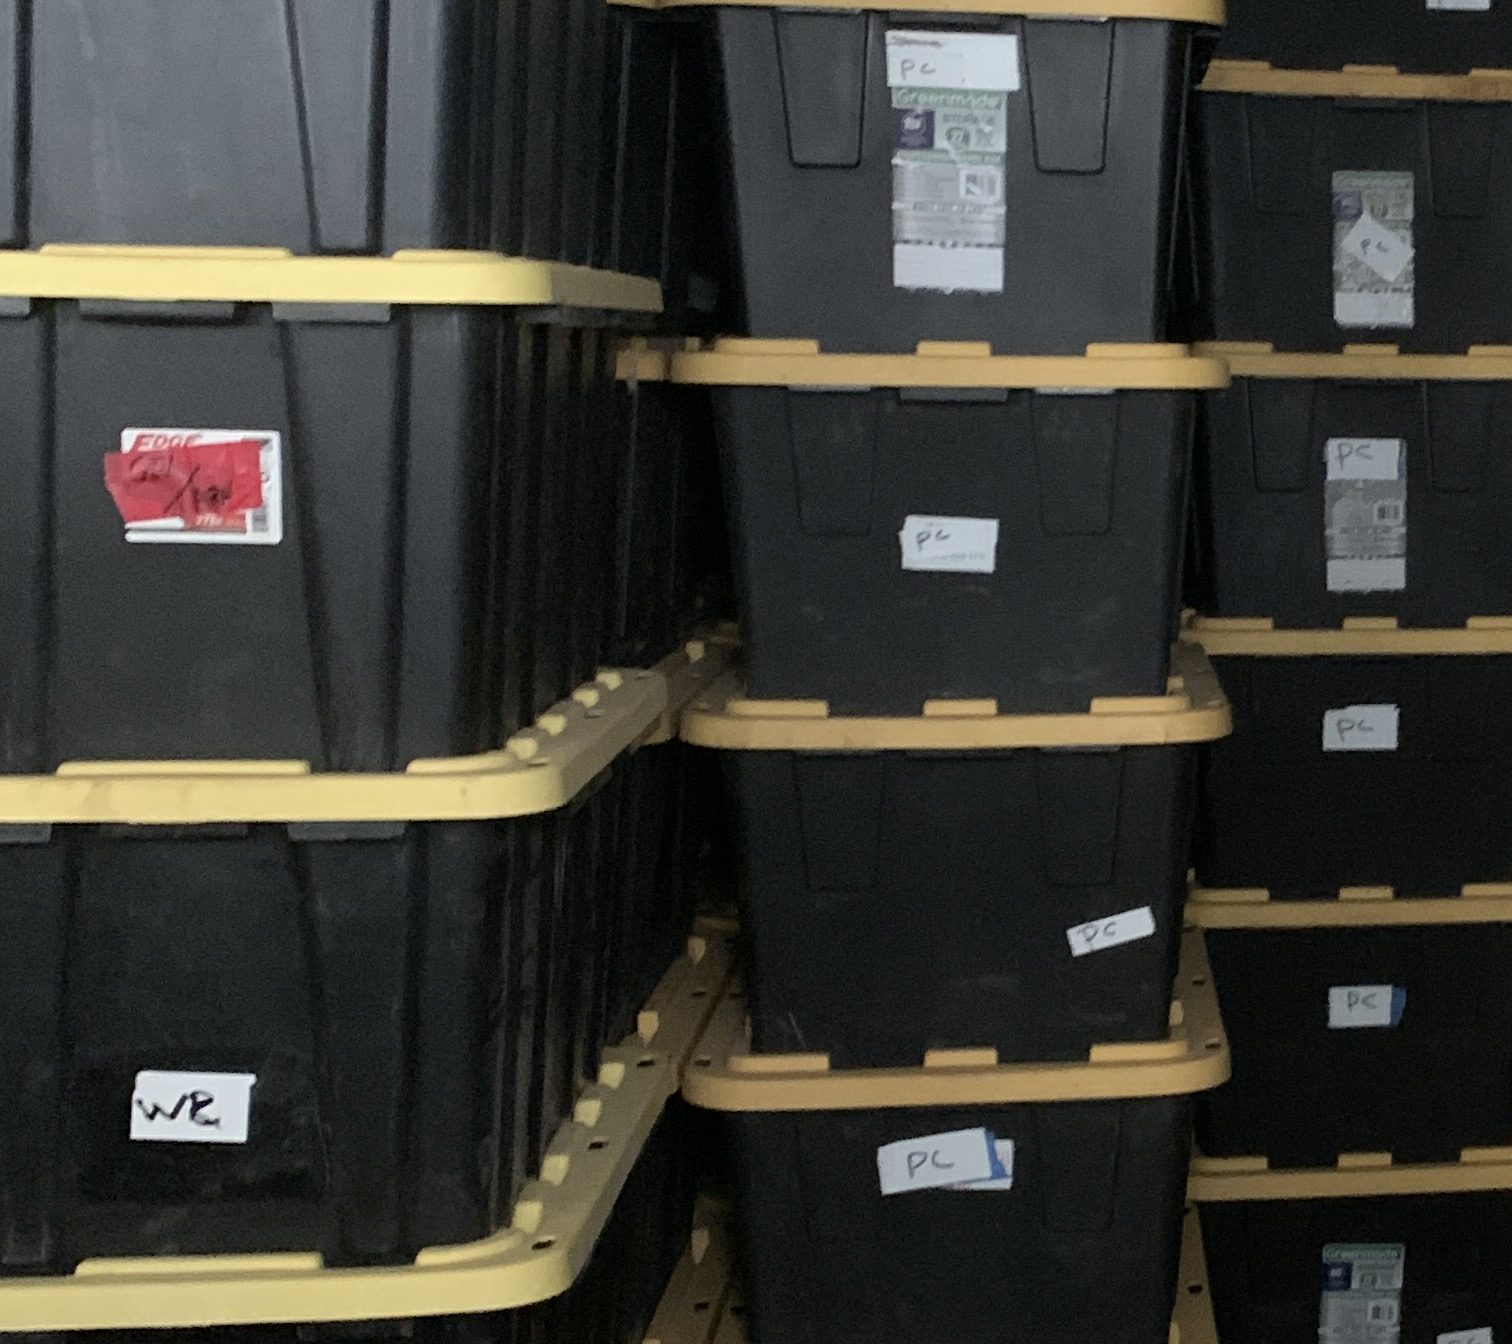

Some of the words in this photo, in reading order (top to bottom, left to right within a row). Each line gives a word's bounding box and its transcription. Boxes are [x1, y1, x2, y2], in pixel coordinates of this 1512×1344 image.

[900, 58, 936, 81] PC
[1335, 442, 1373, 471] PC
[916, 529, 951, 552] PC
[1336, 718, 1373, 743] PC
[1077, 920, 1117, 949] PC
[906, 1150, 954, 1179] PC
